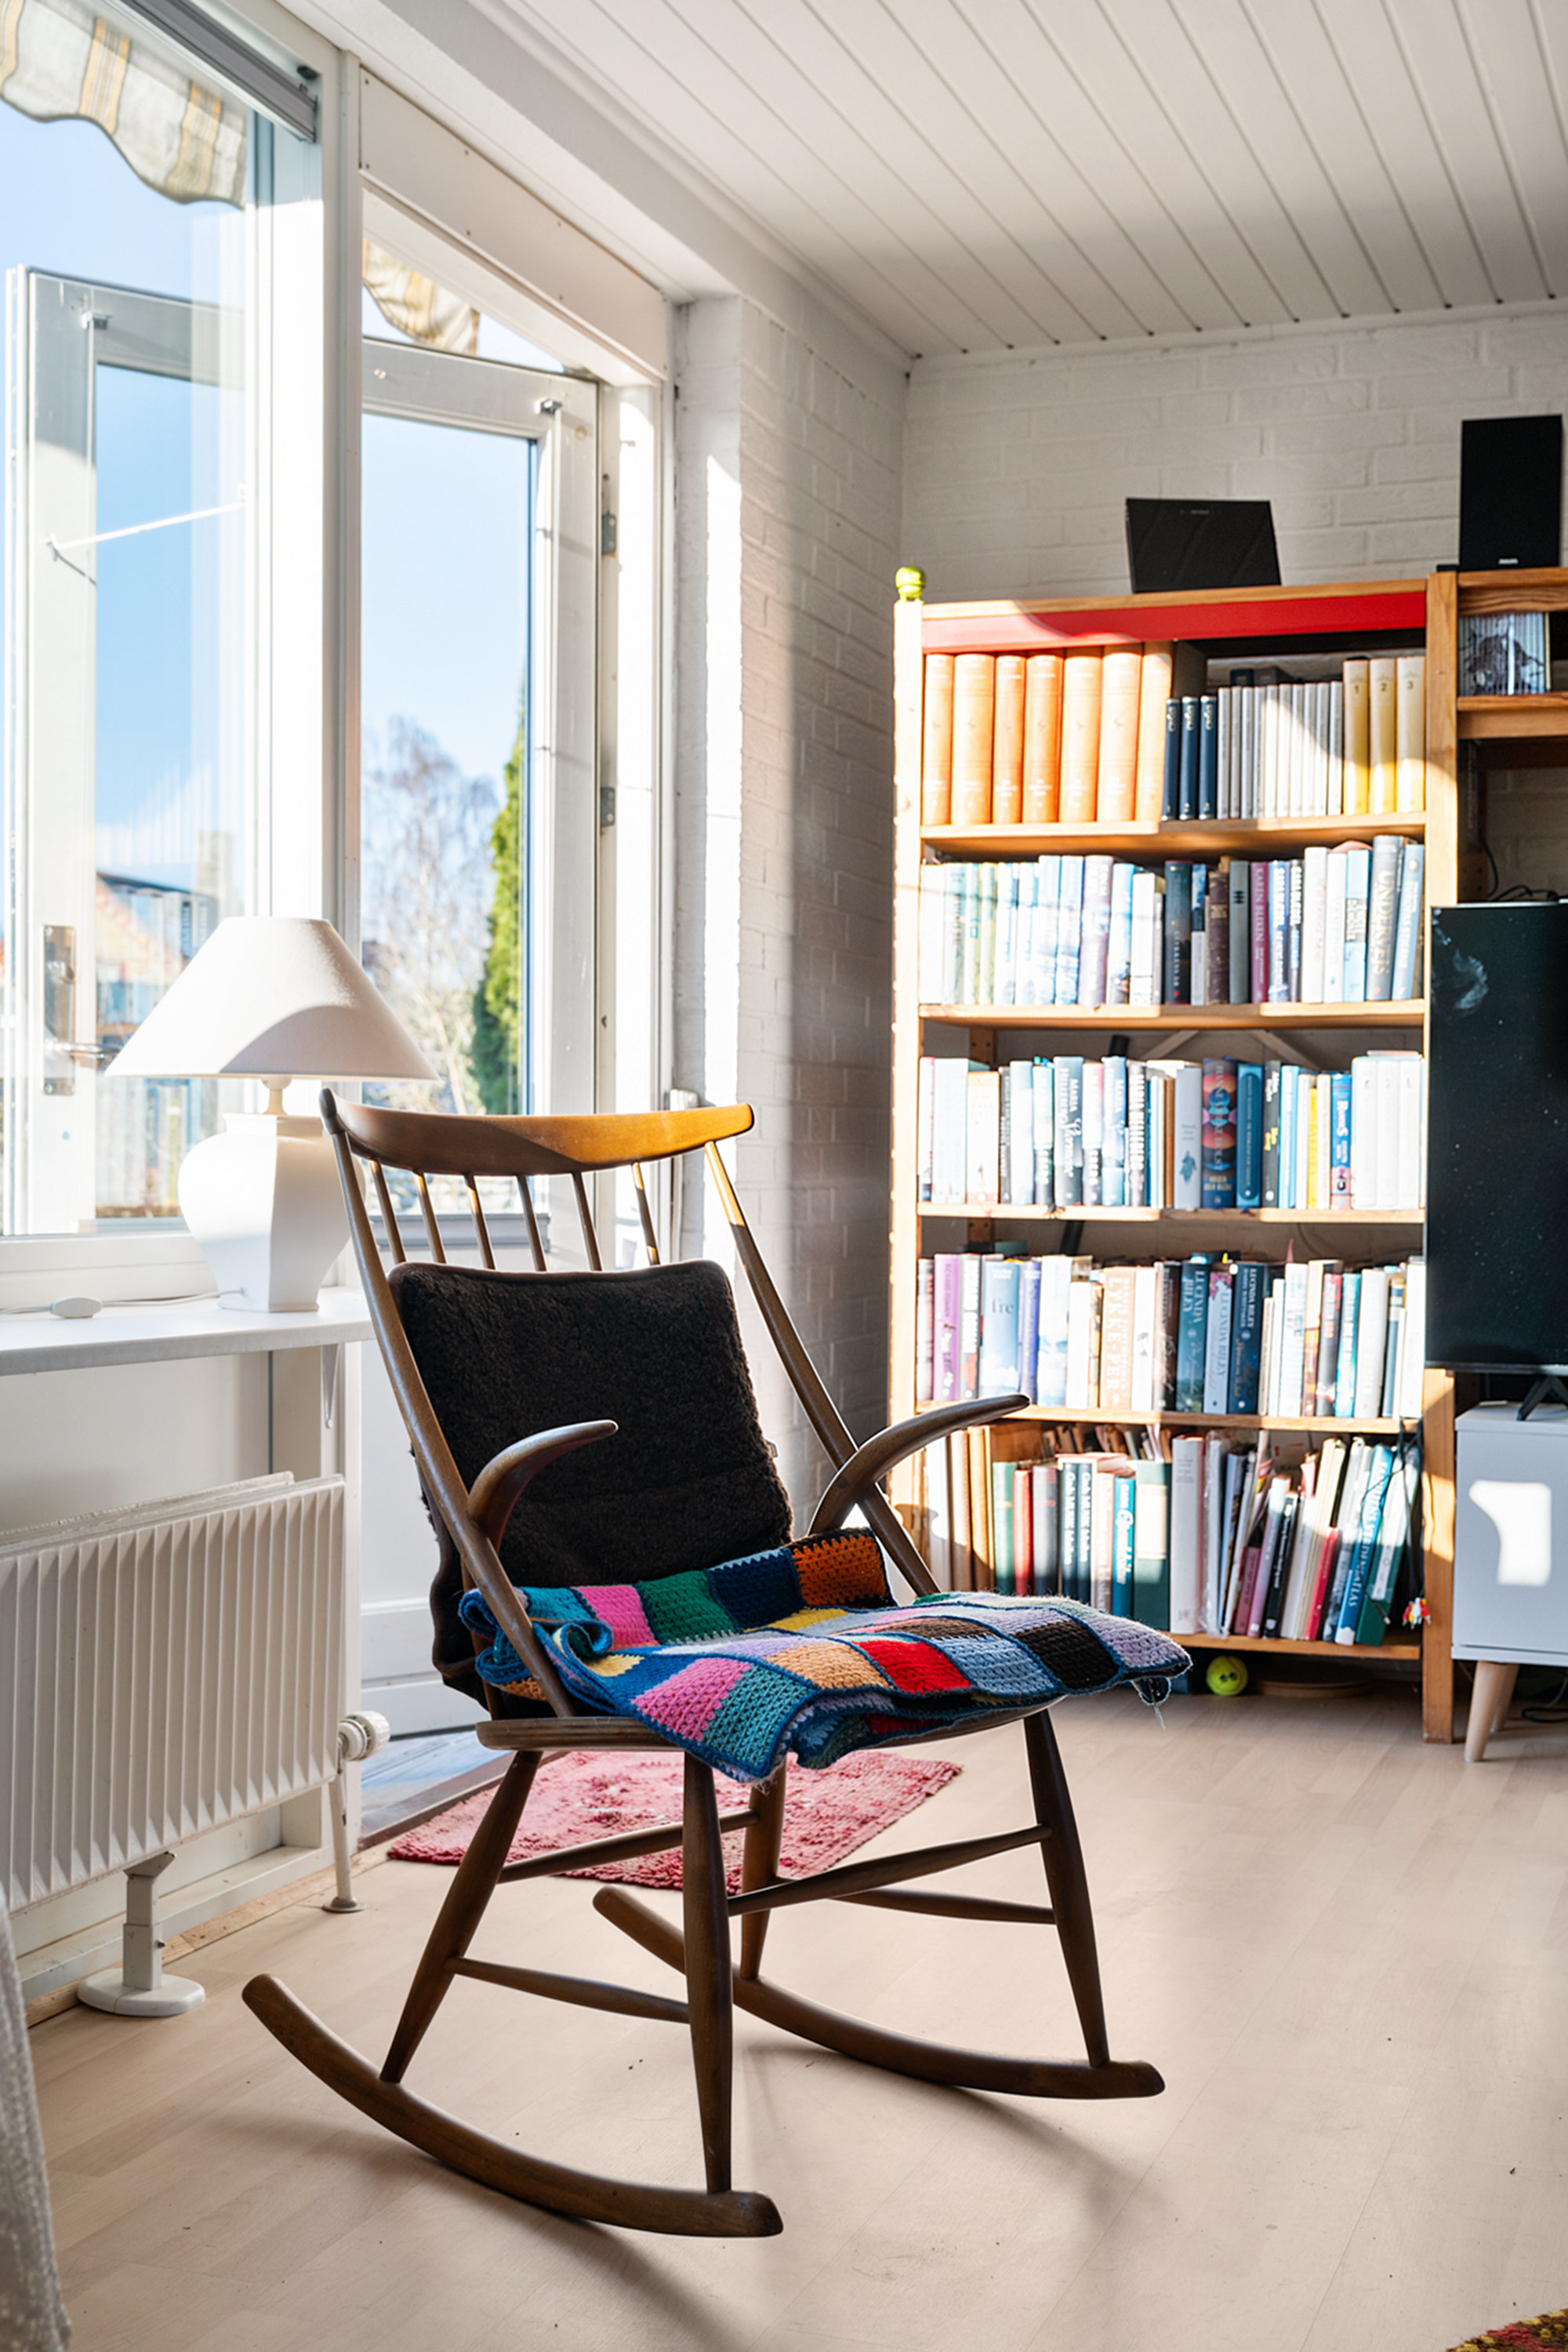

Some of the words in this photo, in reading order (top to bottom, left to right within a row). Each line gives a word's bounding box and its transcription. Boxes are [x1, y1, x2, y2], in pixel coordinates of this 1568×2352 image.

[1373, 870, 1394, 975] UNDERVEJS
[1069, 1079, 1078, 1112] MARIA
[1183, 1278, 1193, 1312] RILEY
[1192, 1270, 1205, 1323] LUCINDA
[1247, 1268, 1257, 1304] LUCINDA
[1106, 1277, 1123, 1389] LYKKE-PER
[1218, 1293, 1229, 1342] LUCINDA
[1246, 1304, 1255, 1327] RILEY
[1217, 1344, 1229, 1377] RILEY
